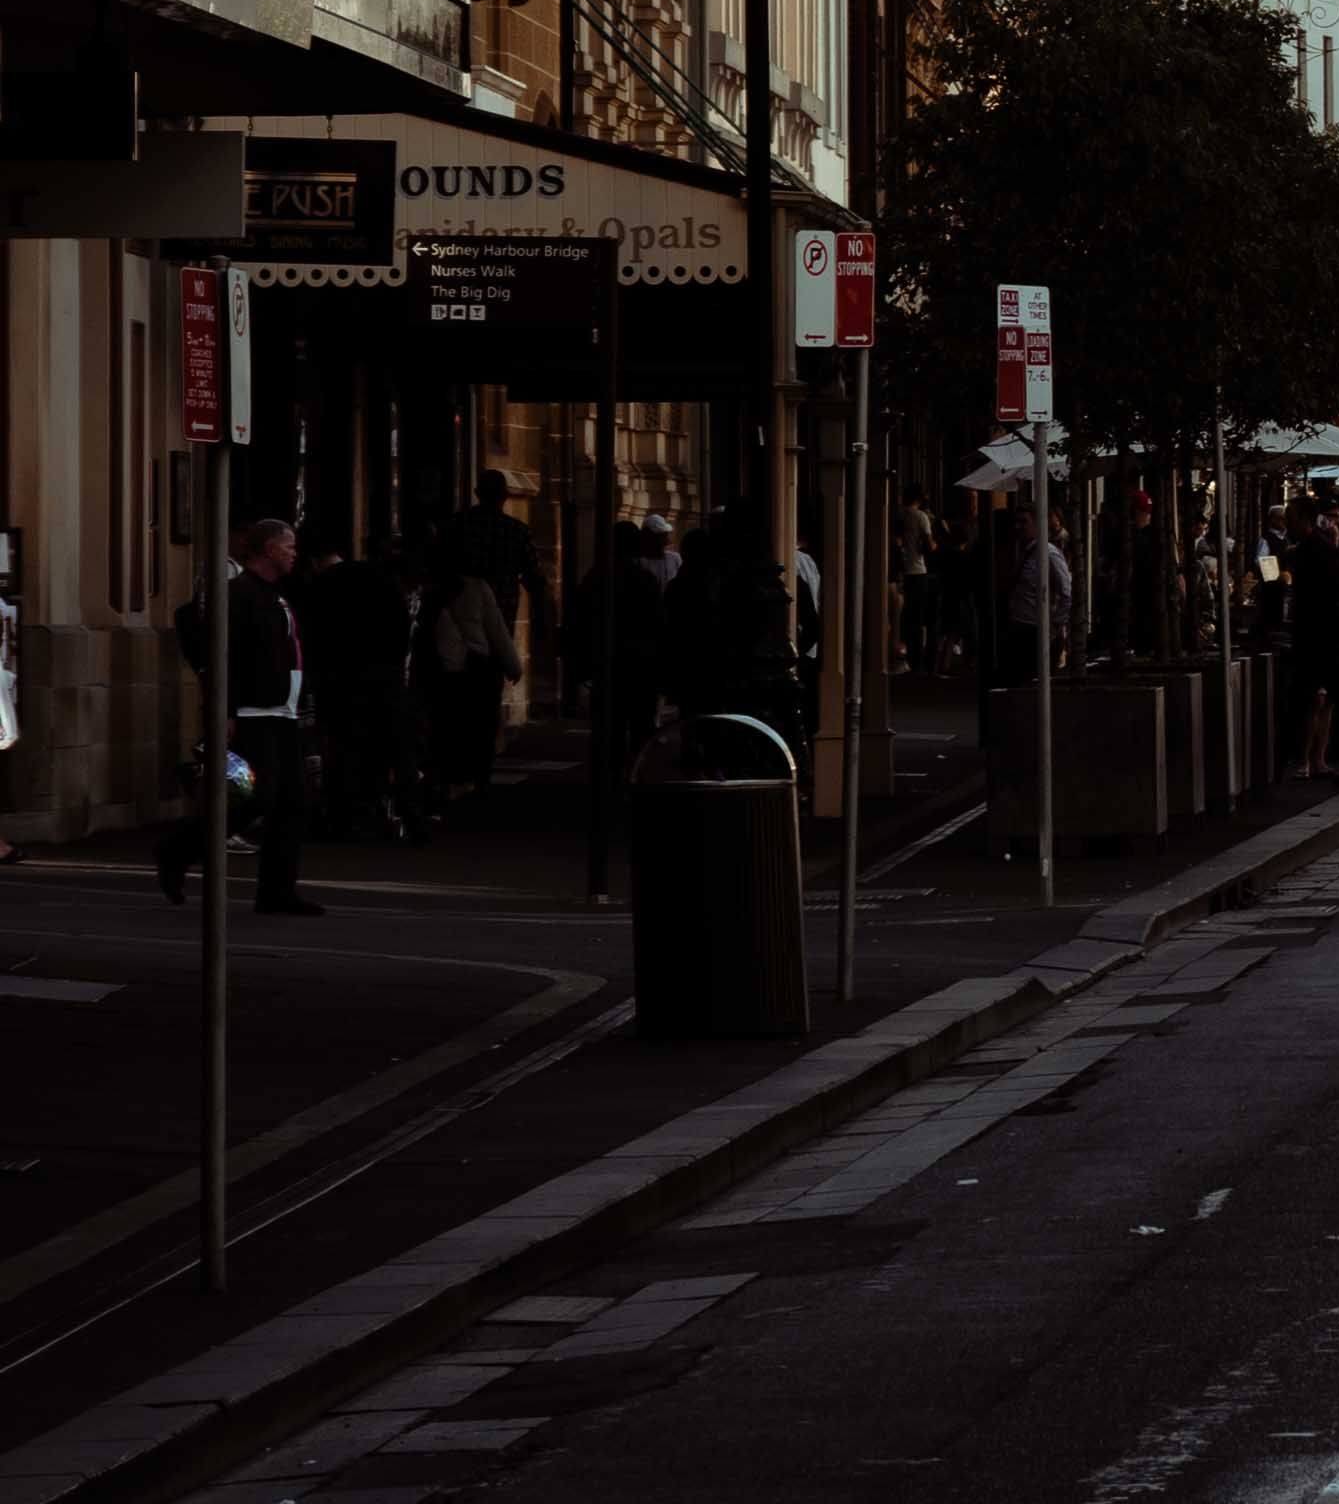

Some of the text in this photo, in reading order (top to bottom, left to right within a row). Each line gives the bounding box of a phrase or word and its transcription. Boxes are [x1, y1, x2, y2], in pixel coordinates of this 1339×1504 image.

[272, 184, 356, 217] PUSH
[598, 217, 721, 262] Opals
[847, 239, 863, 257] NO
[431, 243, 590, 261] Sydney Harbour Bridge
[431, 264, 517, 278] Nurses Walk
[837, 262, 874, 277] STOPPING
[431, 285, 511, 301] The Big Dig
